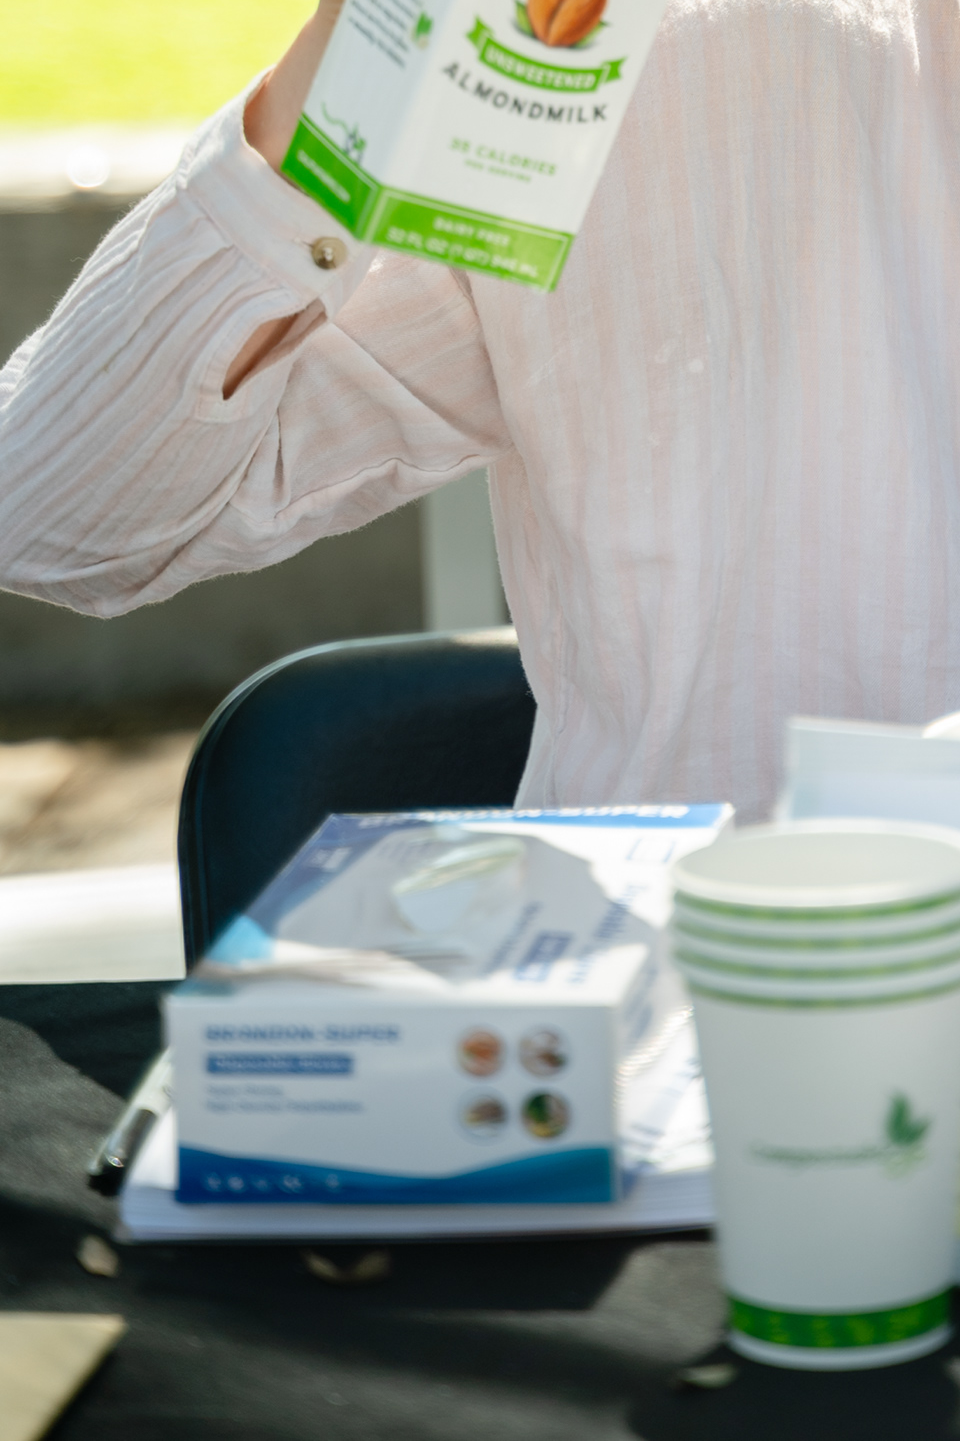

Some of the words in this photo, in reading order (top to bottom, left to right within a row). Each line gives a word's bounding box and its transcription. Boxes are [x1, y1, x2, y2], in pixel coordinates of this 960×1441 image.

[484, 43, 598, 91] UNSWEETENED
[442, 61, 608, 124] ALMONDMILK
[475, 144, 558, 177] CALORIES
[432, 216, 475, 238] DAIRY
[475, 226, 512, 248] FREE
